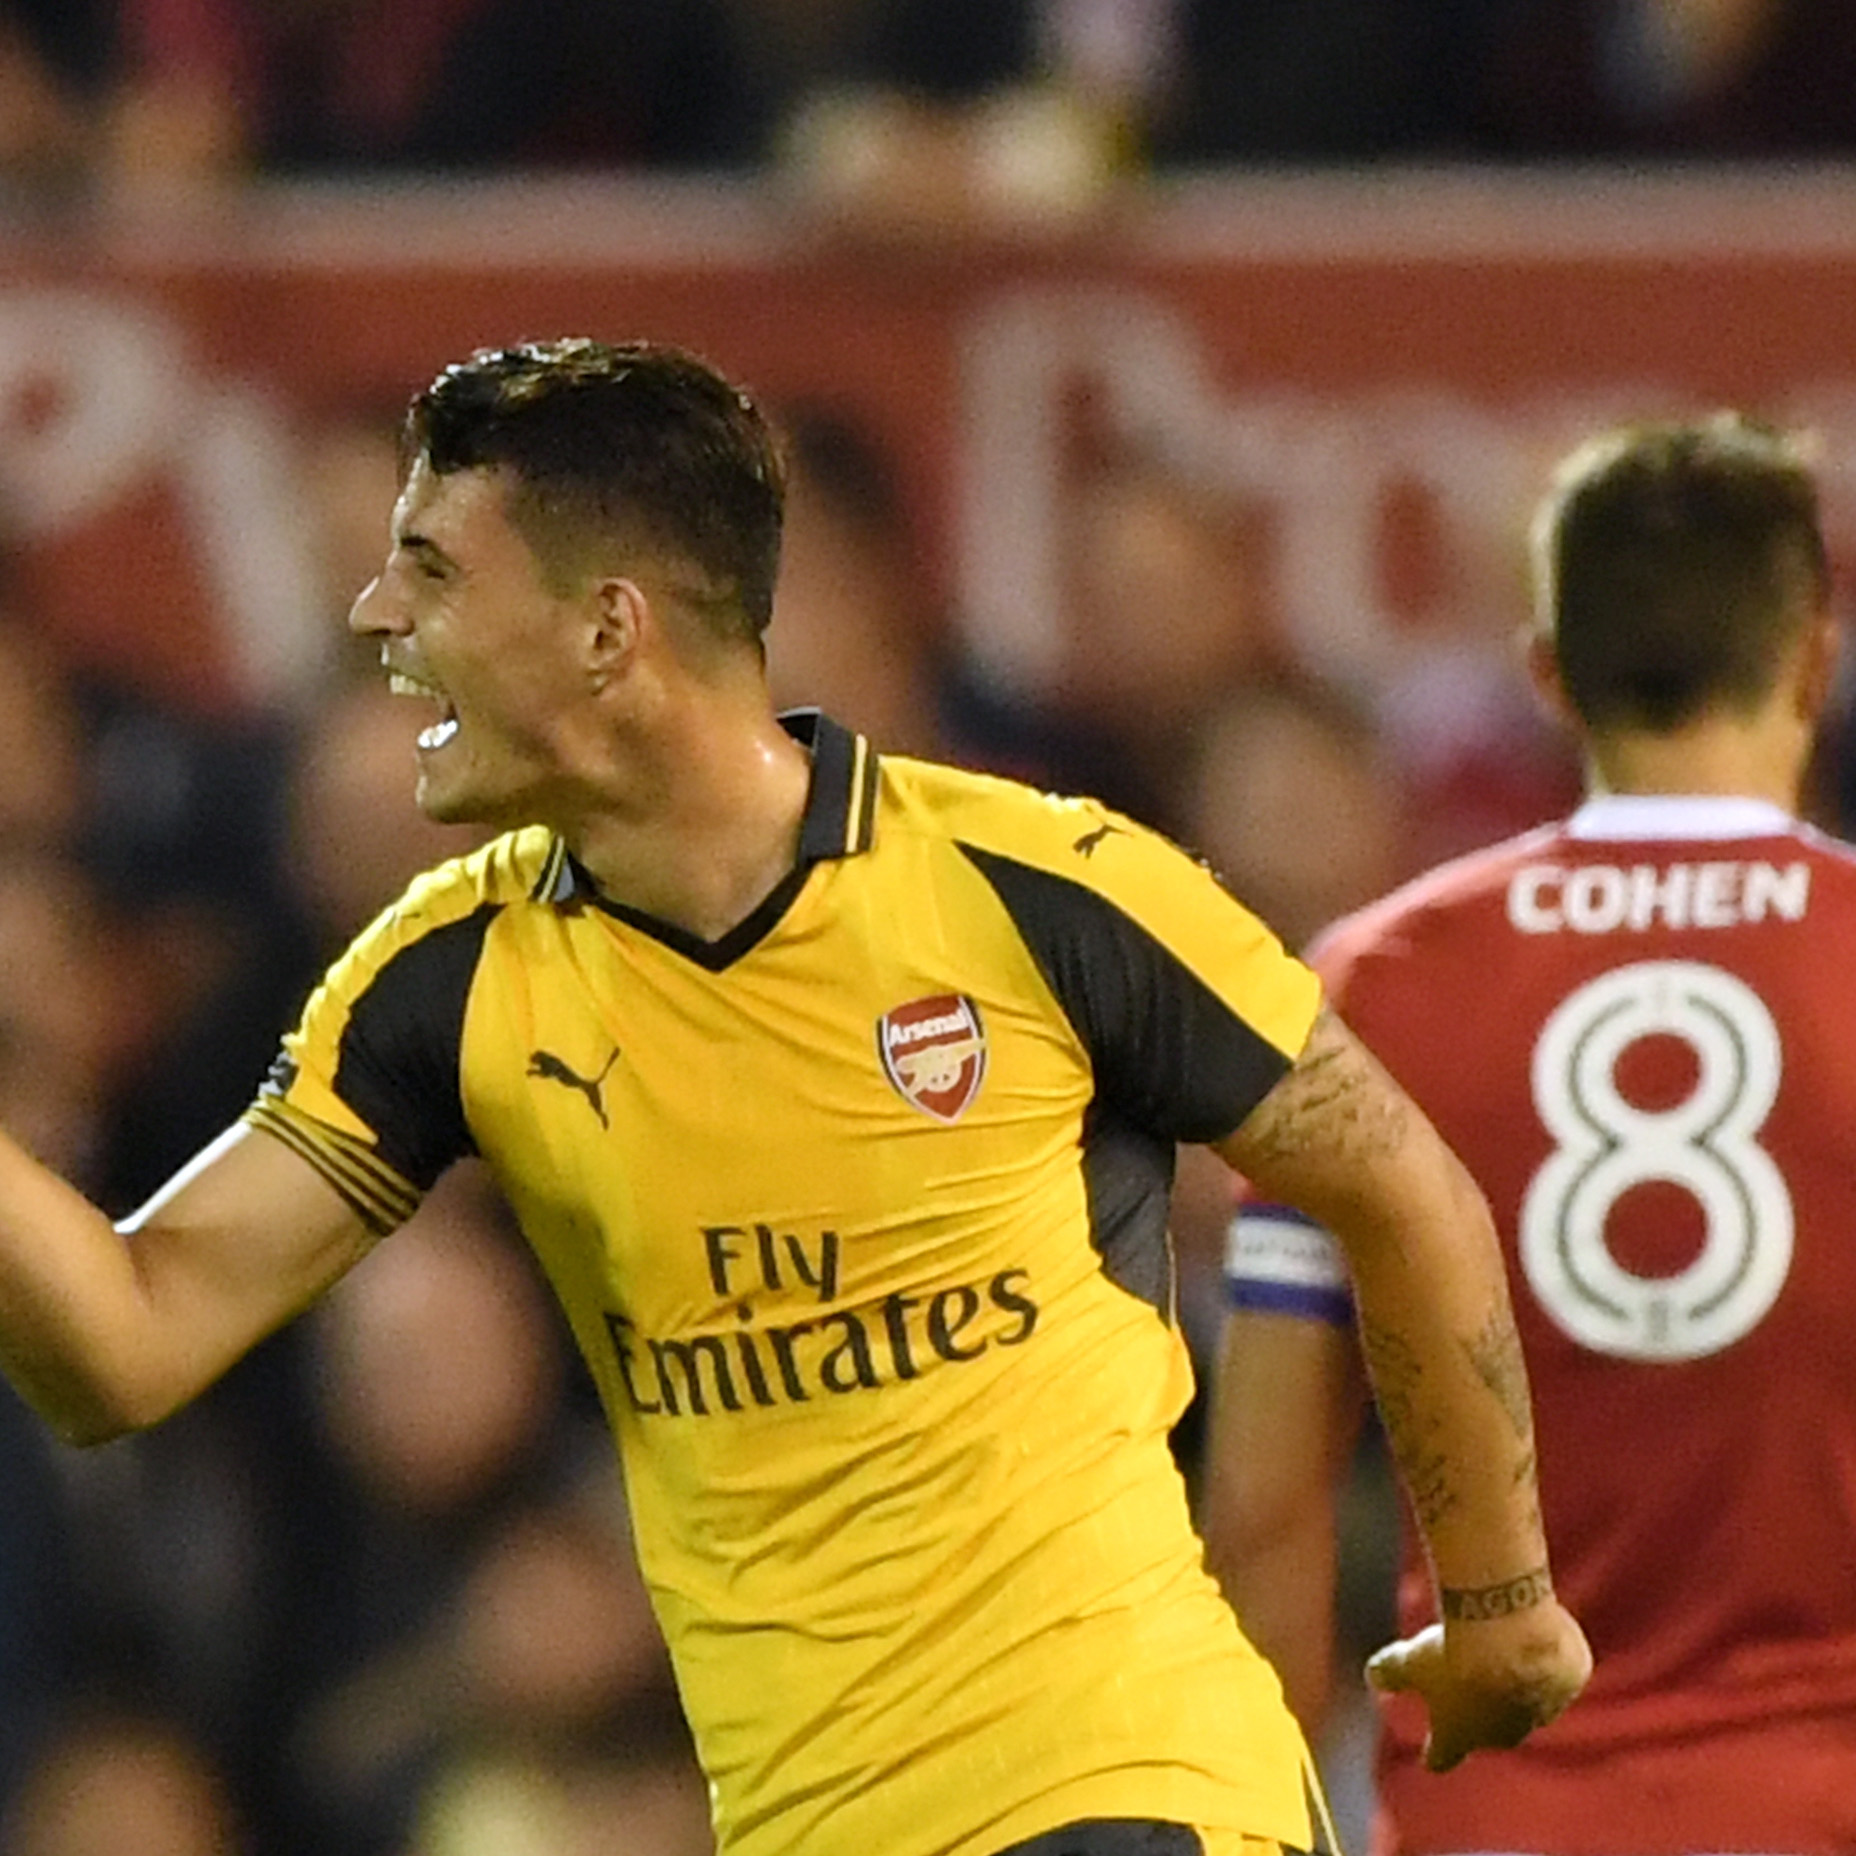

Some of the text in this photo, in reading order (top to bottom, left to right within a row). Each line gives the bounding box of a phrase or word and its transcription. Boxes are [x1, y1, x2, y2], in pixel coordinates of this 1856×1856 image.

[1506, 860, 1812, 935] COHEN
[889, 1007, 969, 1047] Arsenal
[1517, 958, 1796, 1364] 8
[700, 1222, 840, 1302] Fly
[602, 1266, 1040, 1417] Emirates
